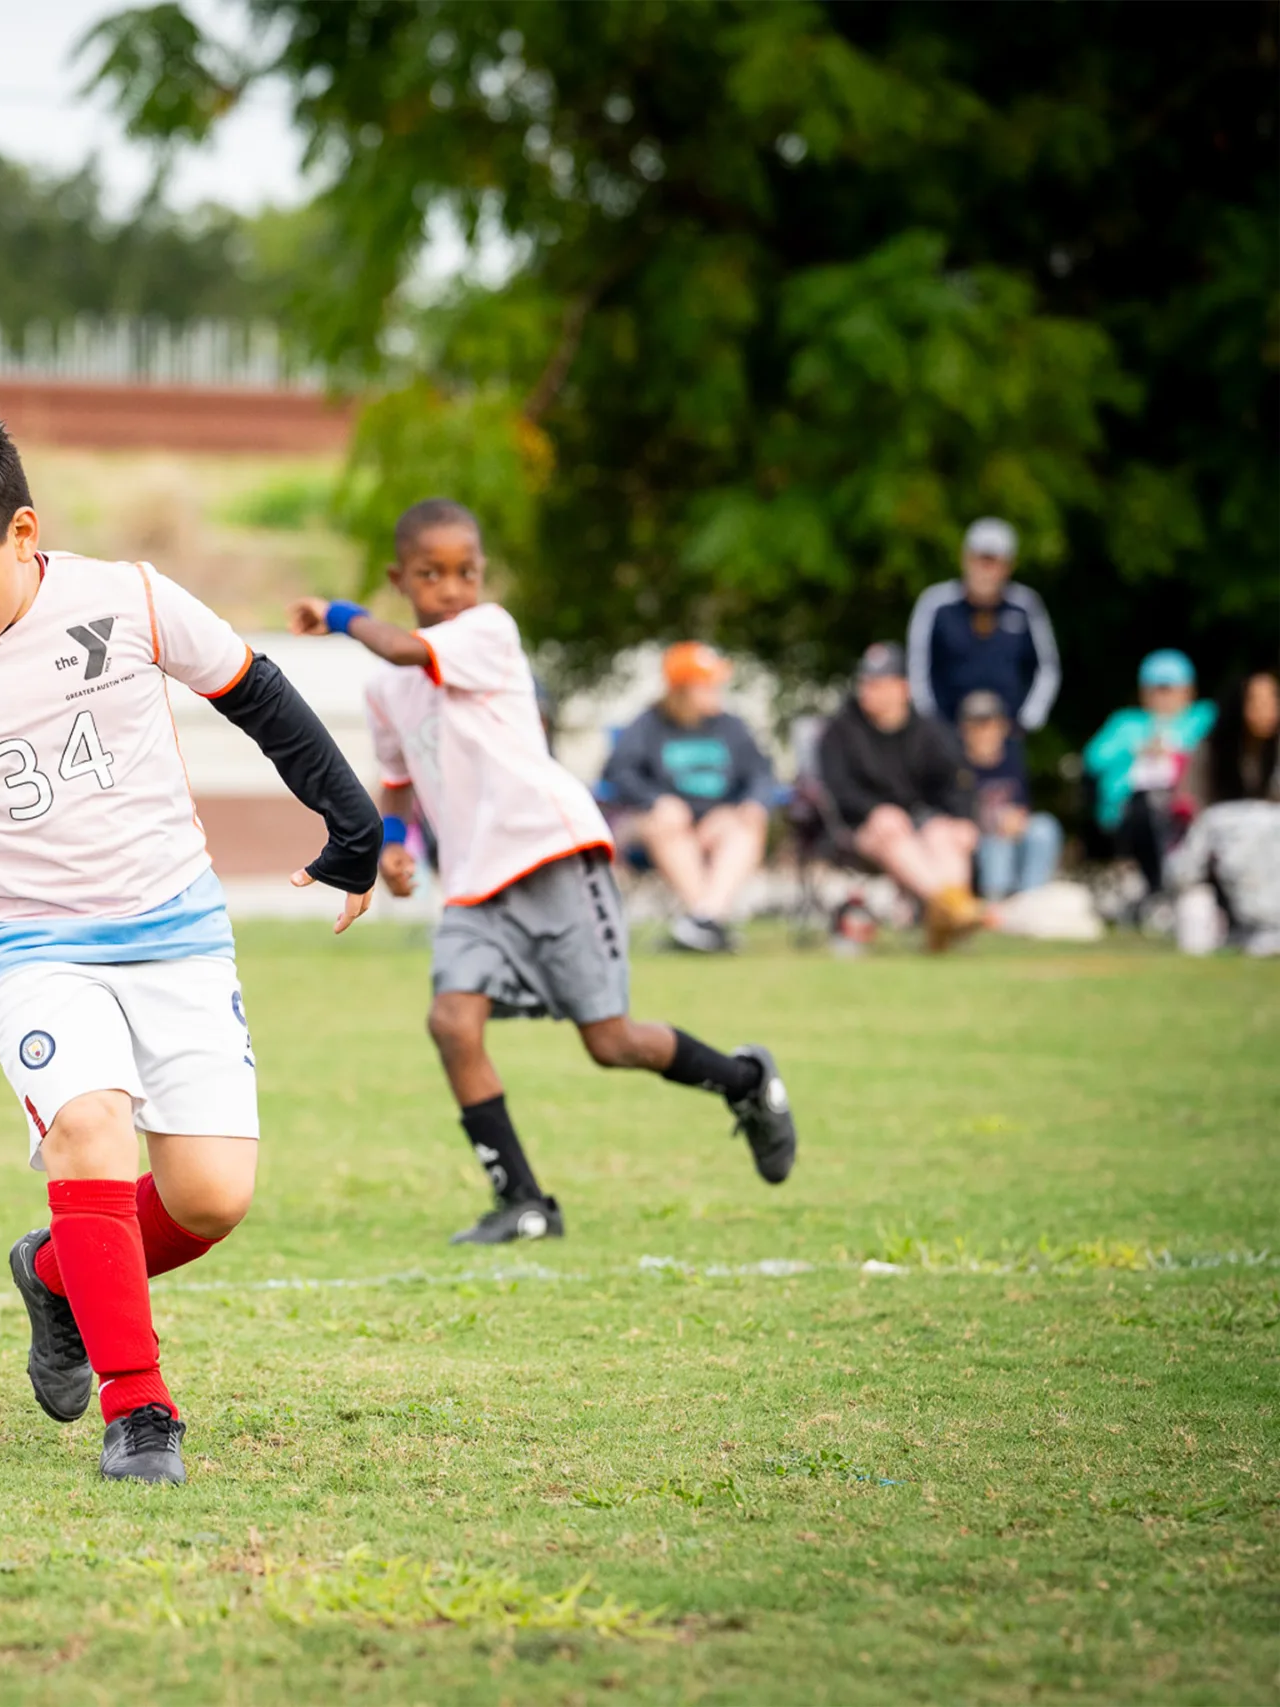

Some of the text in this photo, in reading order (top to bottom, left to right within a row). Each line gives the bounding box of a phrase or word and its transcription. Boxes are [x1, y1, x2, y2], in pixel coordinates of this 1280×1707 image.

[55, 617, 114, 680] the Y
[65, 688, 95, 701] GREATER
[96, 679, 119, 691] AUSTIN
